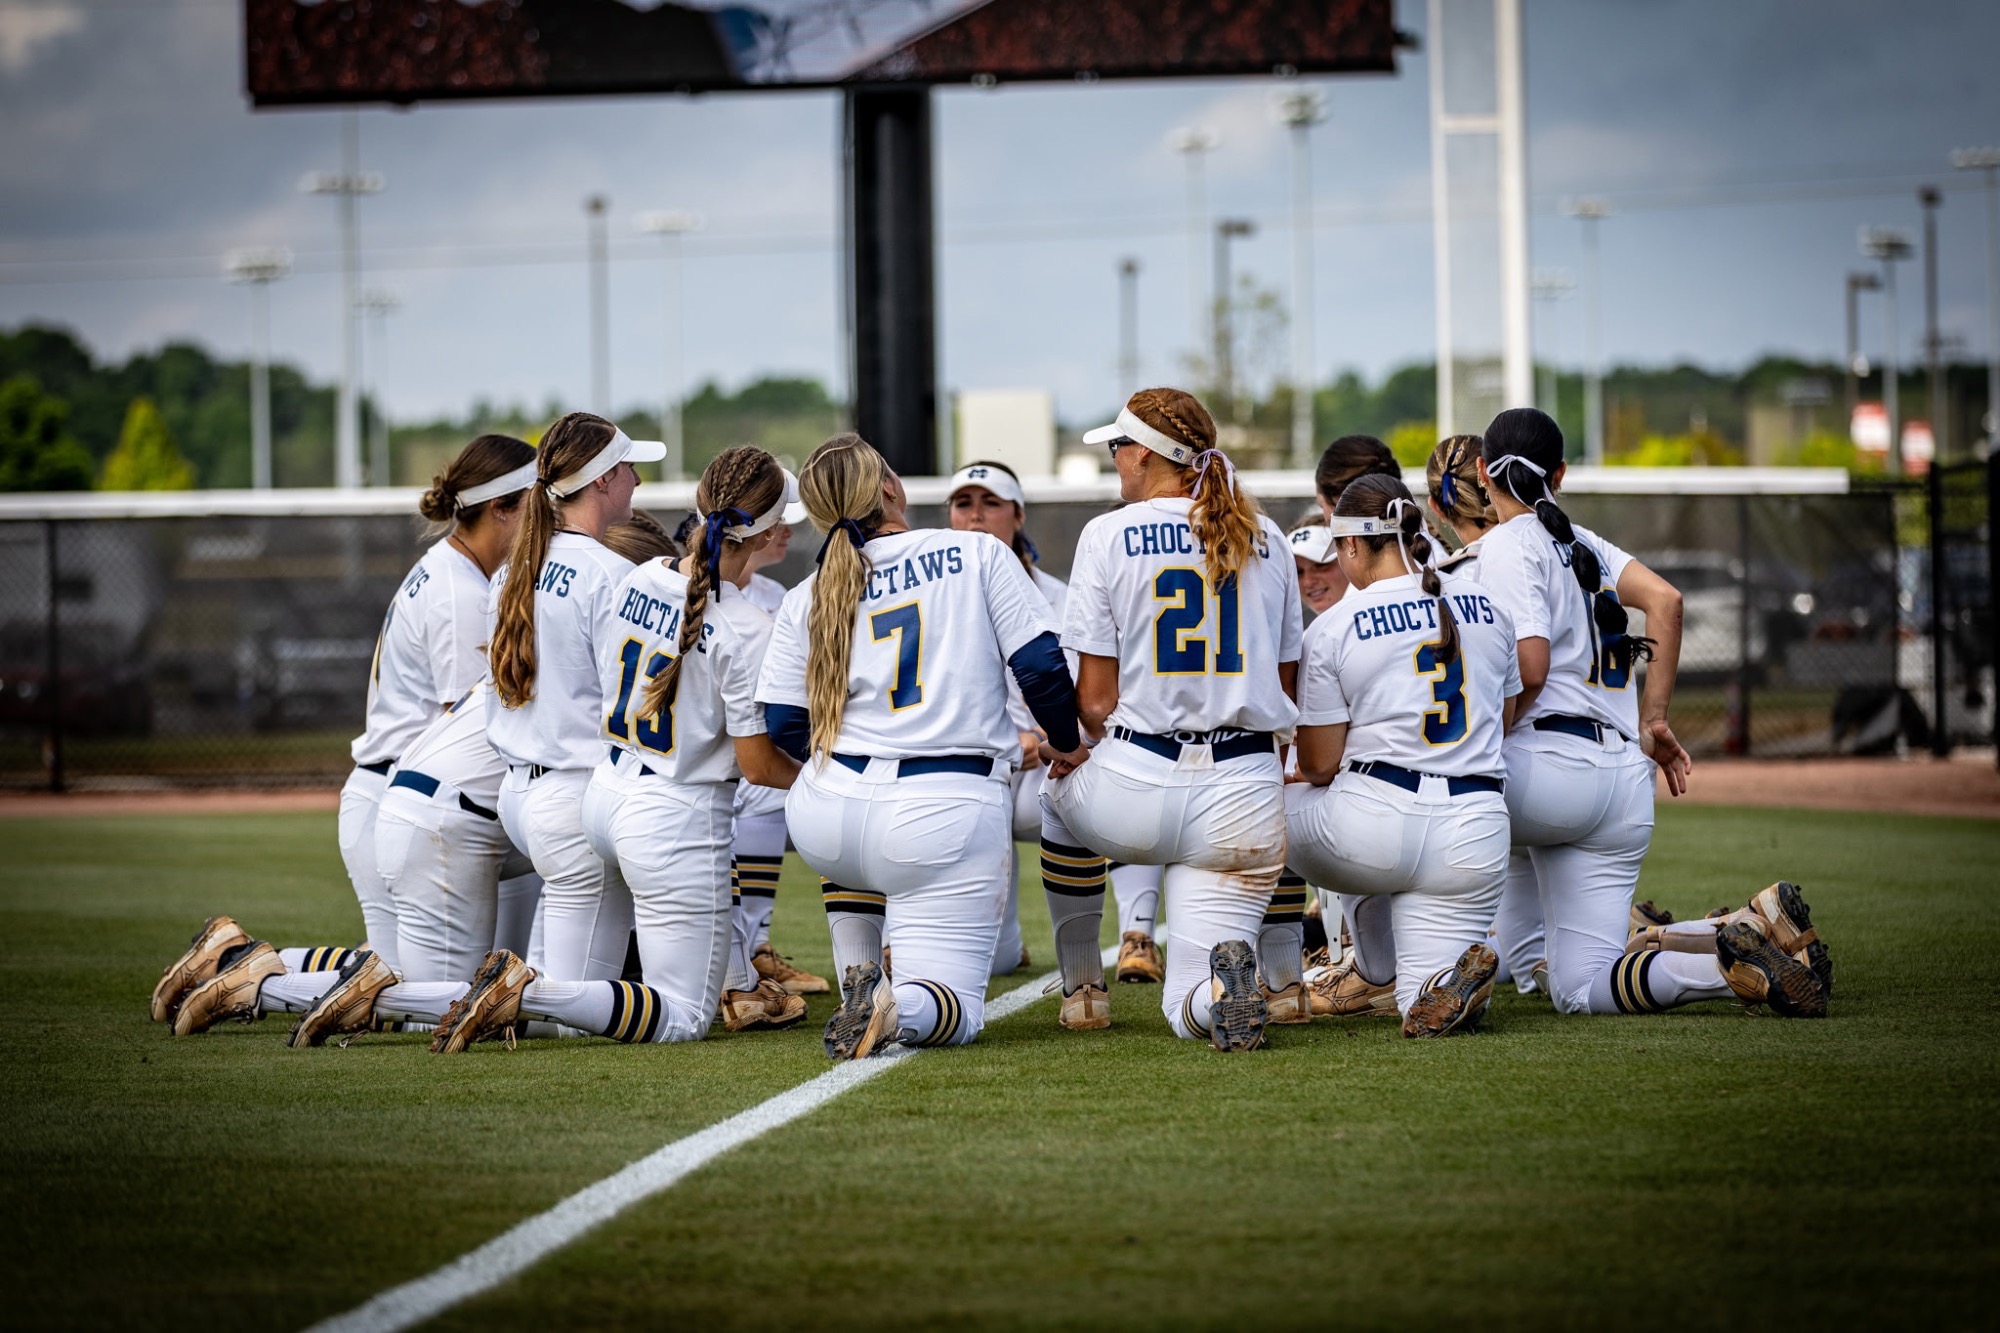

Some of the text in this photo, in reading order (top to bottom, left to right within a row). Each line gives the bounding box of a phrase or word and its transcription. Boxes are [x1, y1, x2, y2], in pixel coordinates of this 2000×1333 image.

[859, 546, 963, 602] CTAWS
[1124, 523, 1270, 559] CHOCS
[618, 586, 715, 654] HOCTAS
[868, 599, 925, 713] 7
[1152, 565, 1247, 676] 21
[1412, 639, 1472, 747] 3
